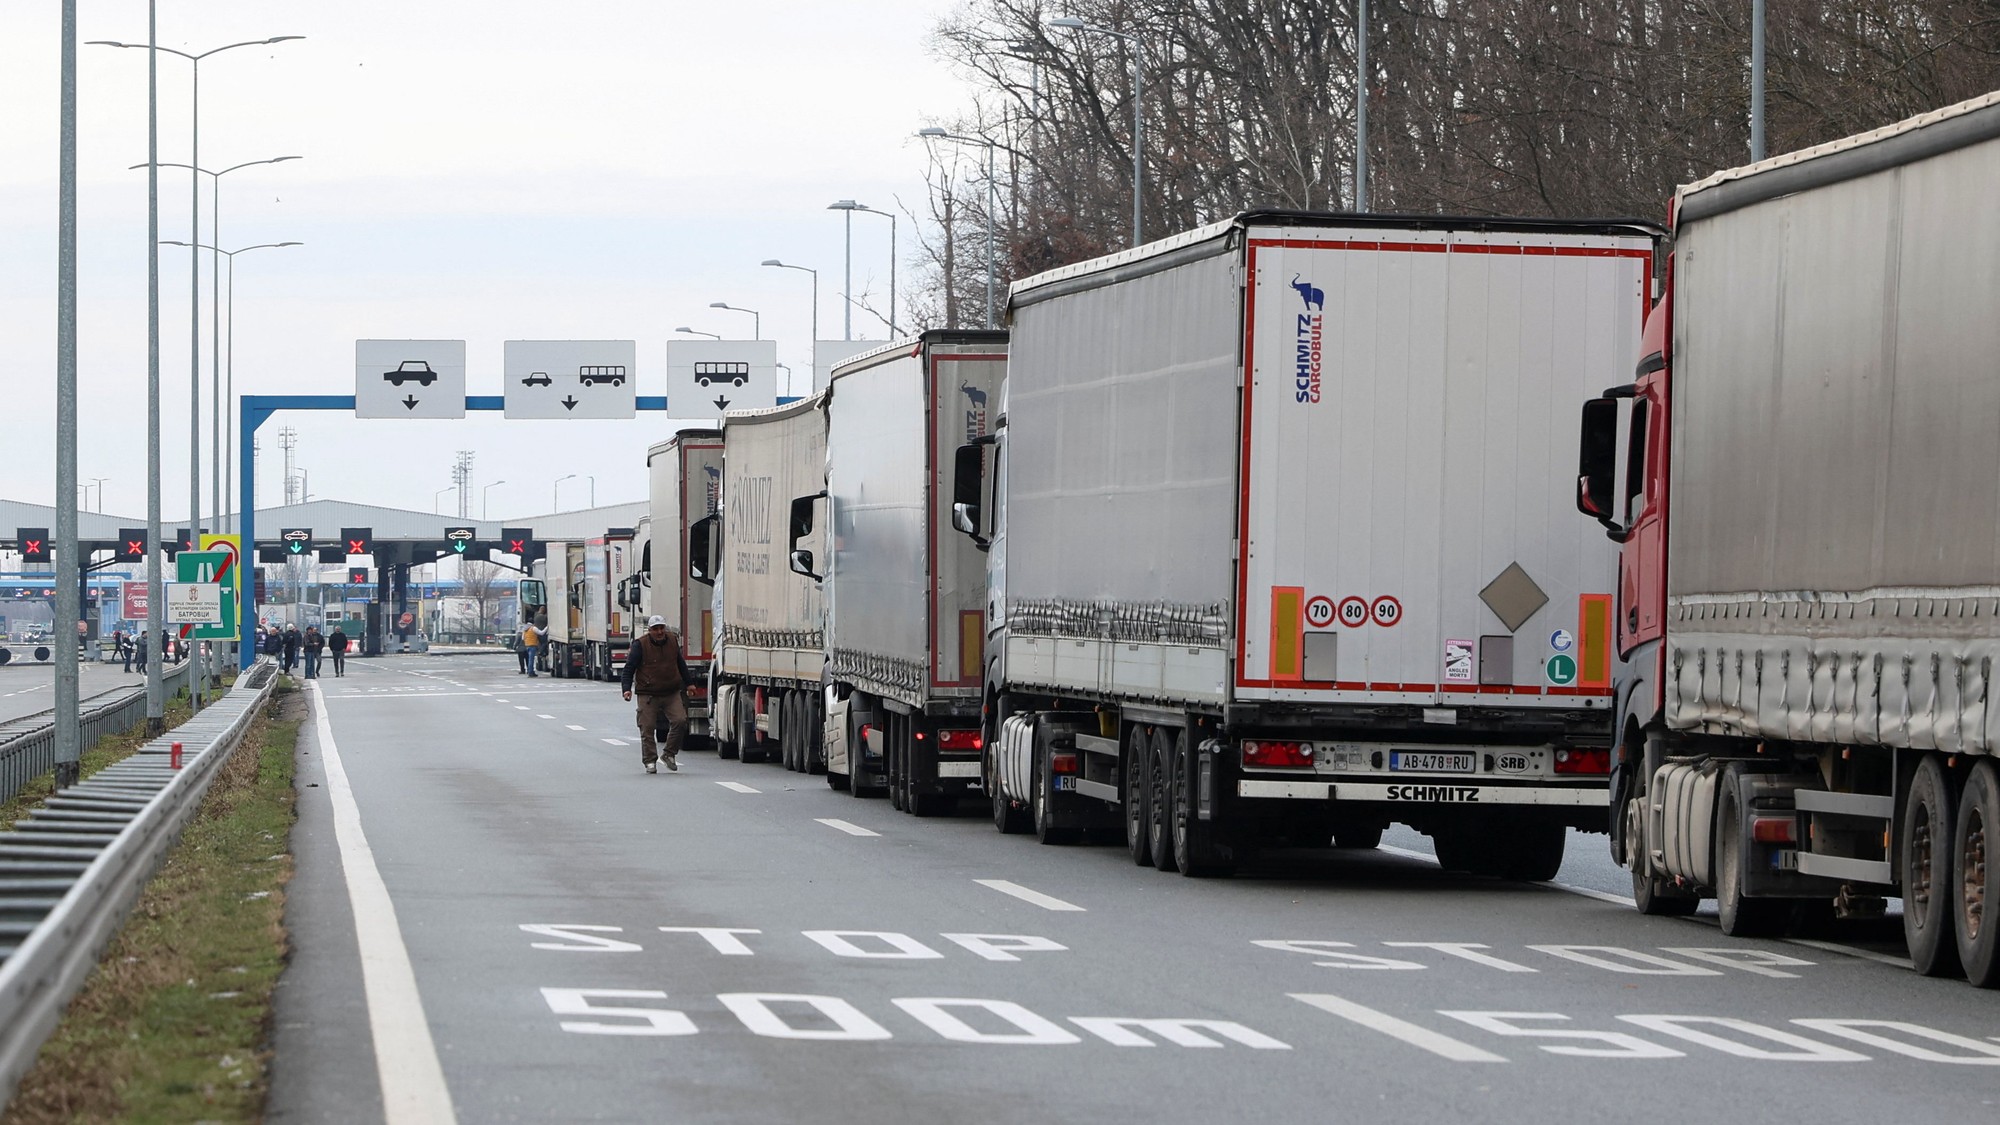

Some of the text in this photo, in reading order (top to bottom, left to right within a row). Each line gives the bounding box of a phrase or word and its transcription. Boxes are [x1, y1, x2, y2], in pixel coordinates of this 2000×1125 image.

[1296, 314, 1310, 403] SCHMITZ
[1310, 315, 1322, 404] CARGOBULL
[133, 600, 148, 608] SER
[1313, 605, 1328, 618] 70
[1346, 605, 1362, 618] 80
[1379, 604, 1395, 618] 90
[1554, 659, 1568, 680] L
[1453, 757, 1469, 770] RU
[1500, 756, 1525, 770] SRB
[1386, 786, 1480, 802] SCHMITZ
[519, 923, 1068, 962] STOP
[1250, 940, 1818, 979] STOP
[540, 988, 1293, 1050] 500m
[1436, 1009, 2000, 1066] 500
